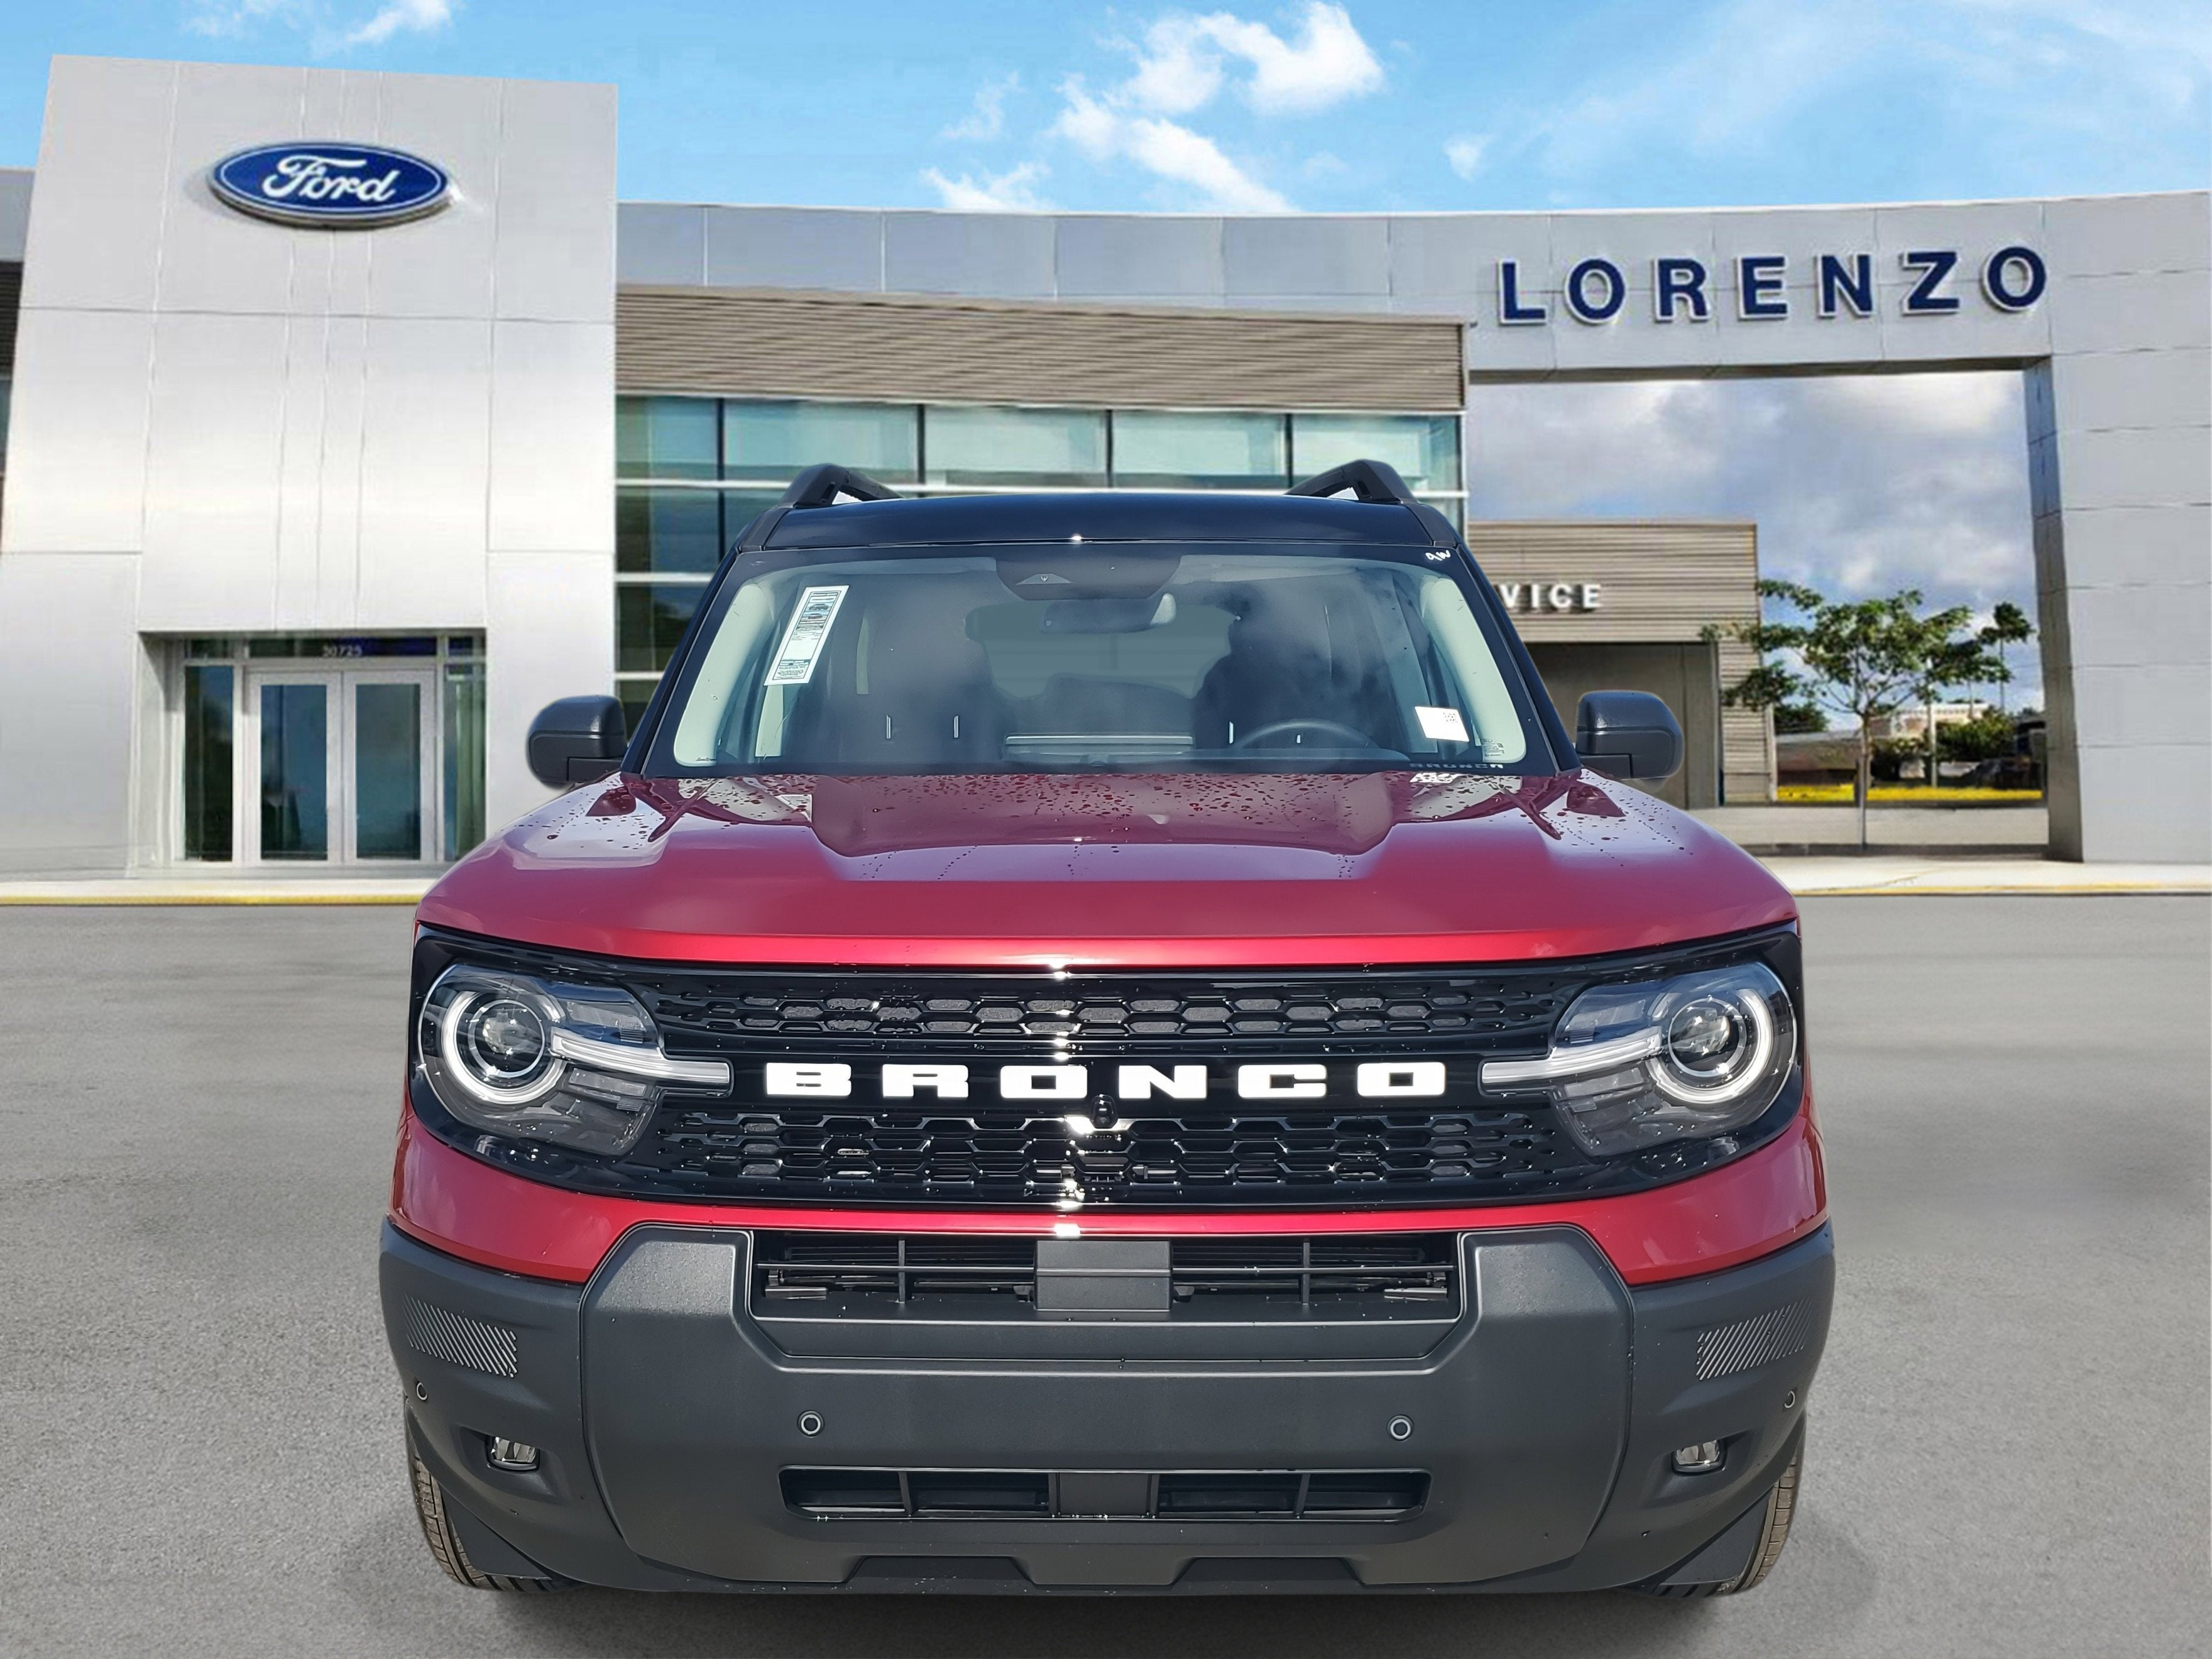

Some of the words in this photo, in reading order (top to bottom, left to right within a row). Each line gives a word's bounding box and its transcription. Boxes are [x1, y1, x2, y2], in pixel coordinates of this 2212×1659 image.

[262, 154, 401, 202] Ford
[1497, 246, 2047, 324] LORENZO
[1499, 583, 1602, 608] VICE
[765, 1061, 1446, 1098] BRONCO
